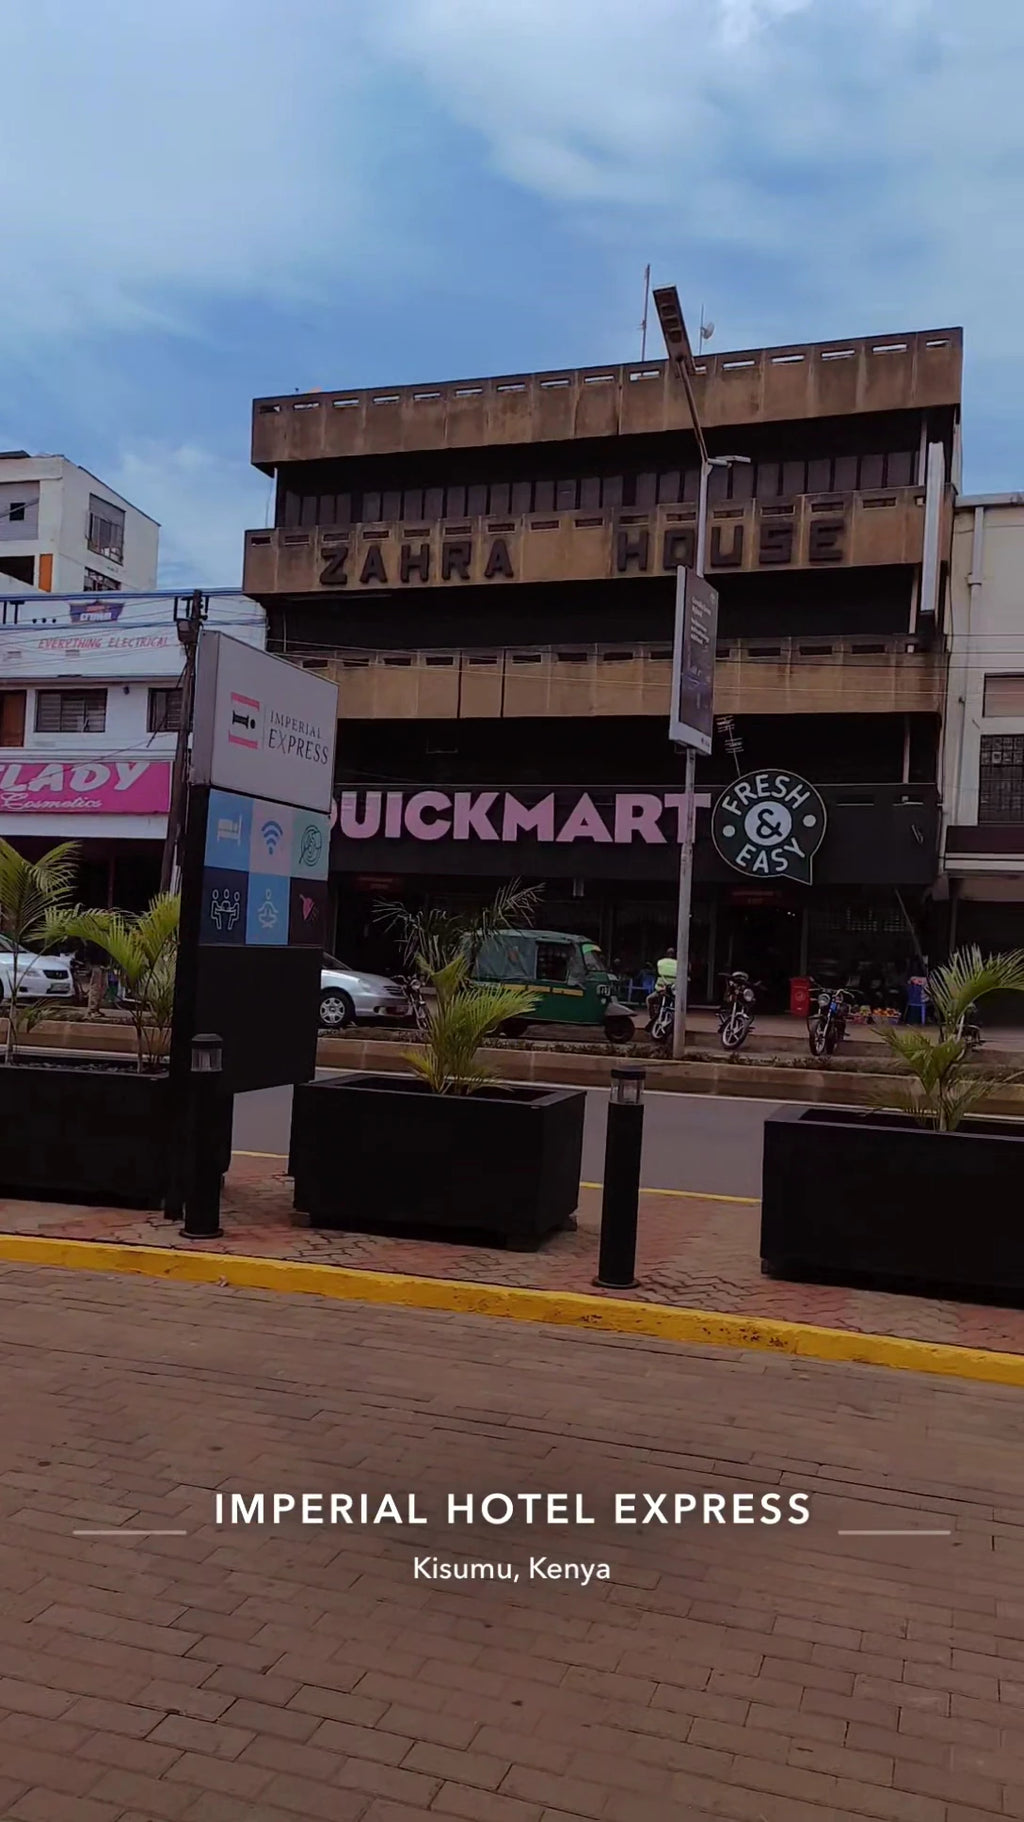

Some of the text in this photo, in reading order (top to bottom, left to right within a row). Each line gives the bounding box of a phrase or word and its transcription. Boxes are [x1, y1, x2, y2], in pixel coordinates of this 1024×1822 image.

[319, 518, 846, 585] ZAHRA HOUSE
[38, 636, 169, 650] EVERYTHING ELECTRICAL
[270, 710, 322, 739] IMPERIAL
[268, 728, 329, 765] EXPRESS
[0, 762, 150, 792] LADY
[1, 792, 103, 810] Cosmetics
[721, 774, 811, 816] FRESH
[331, 790, 711, 844] UICKMART
[755, 808, 783, 840] &
[735, 837, 806, 874] EASY
